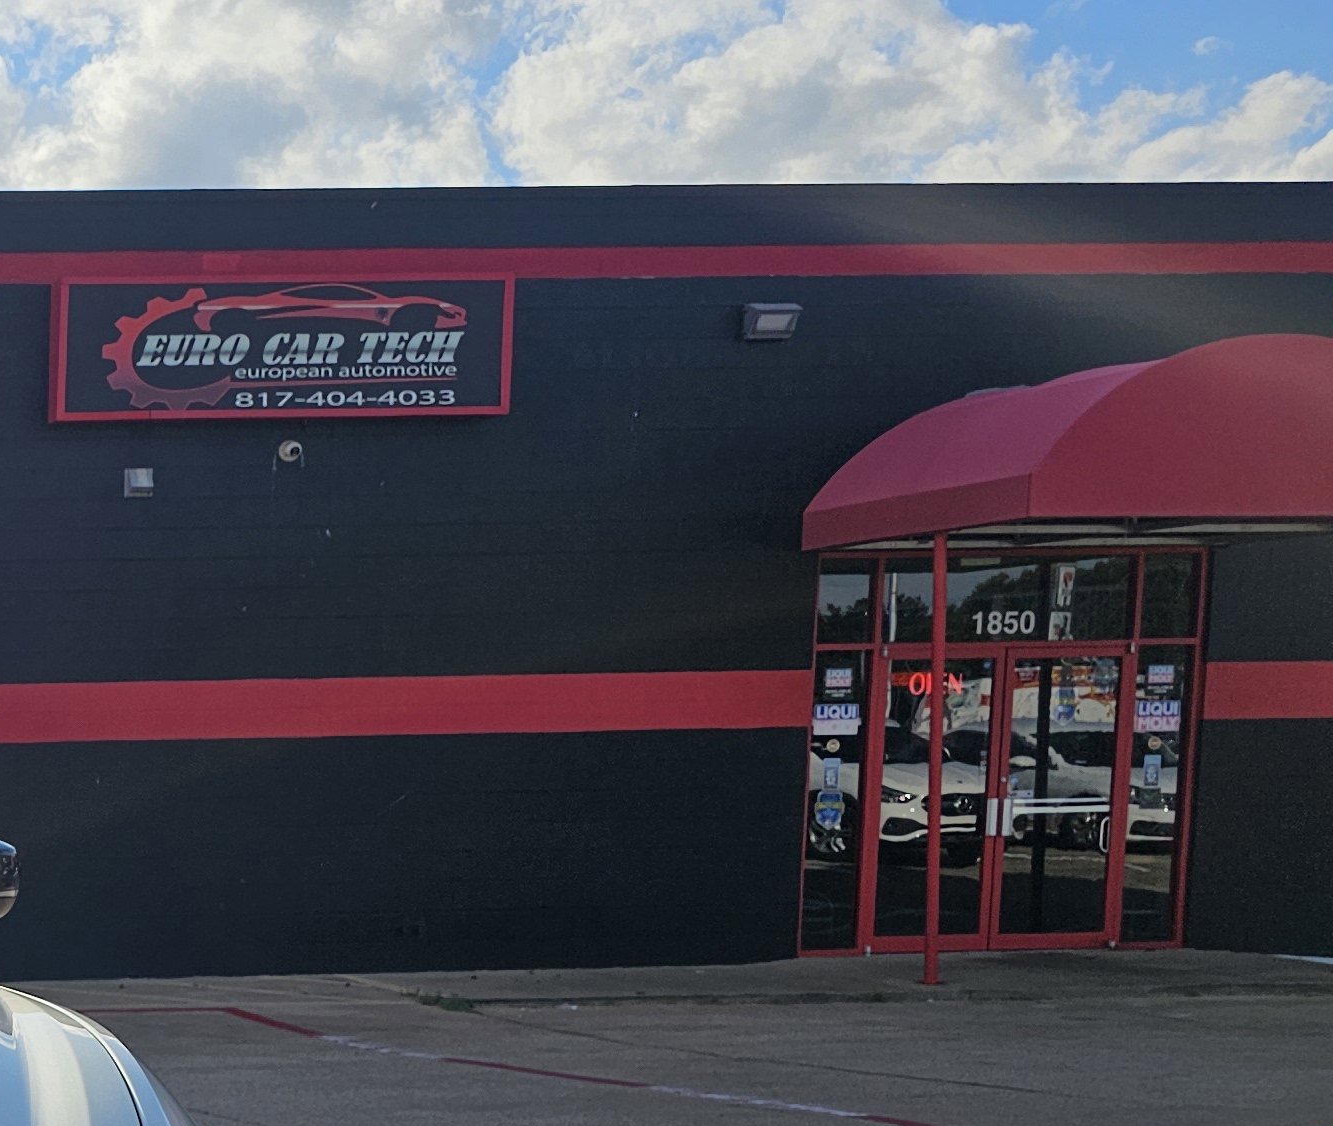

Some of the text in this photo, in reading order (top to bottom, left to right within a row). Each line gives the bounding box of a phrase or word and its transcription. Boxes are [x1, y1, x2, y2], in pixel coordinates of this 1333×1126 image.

[136, 331, 465, 367] EURO CAR TECH
[234, 362, 458, 381] european automotive
[234, 389, 457, 408] 817-404-4033
[972, 610, 1036, 635] 1850
[815, 704, 858, 719] LIQUI
[1138, 701, 1179, 716] LIQUI
[1137, 716, 1180, 732] MOLY
